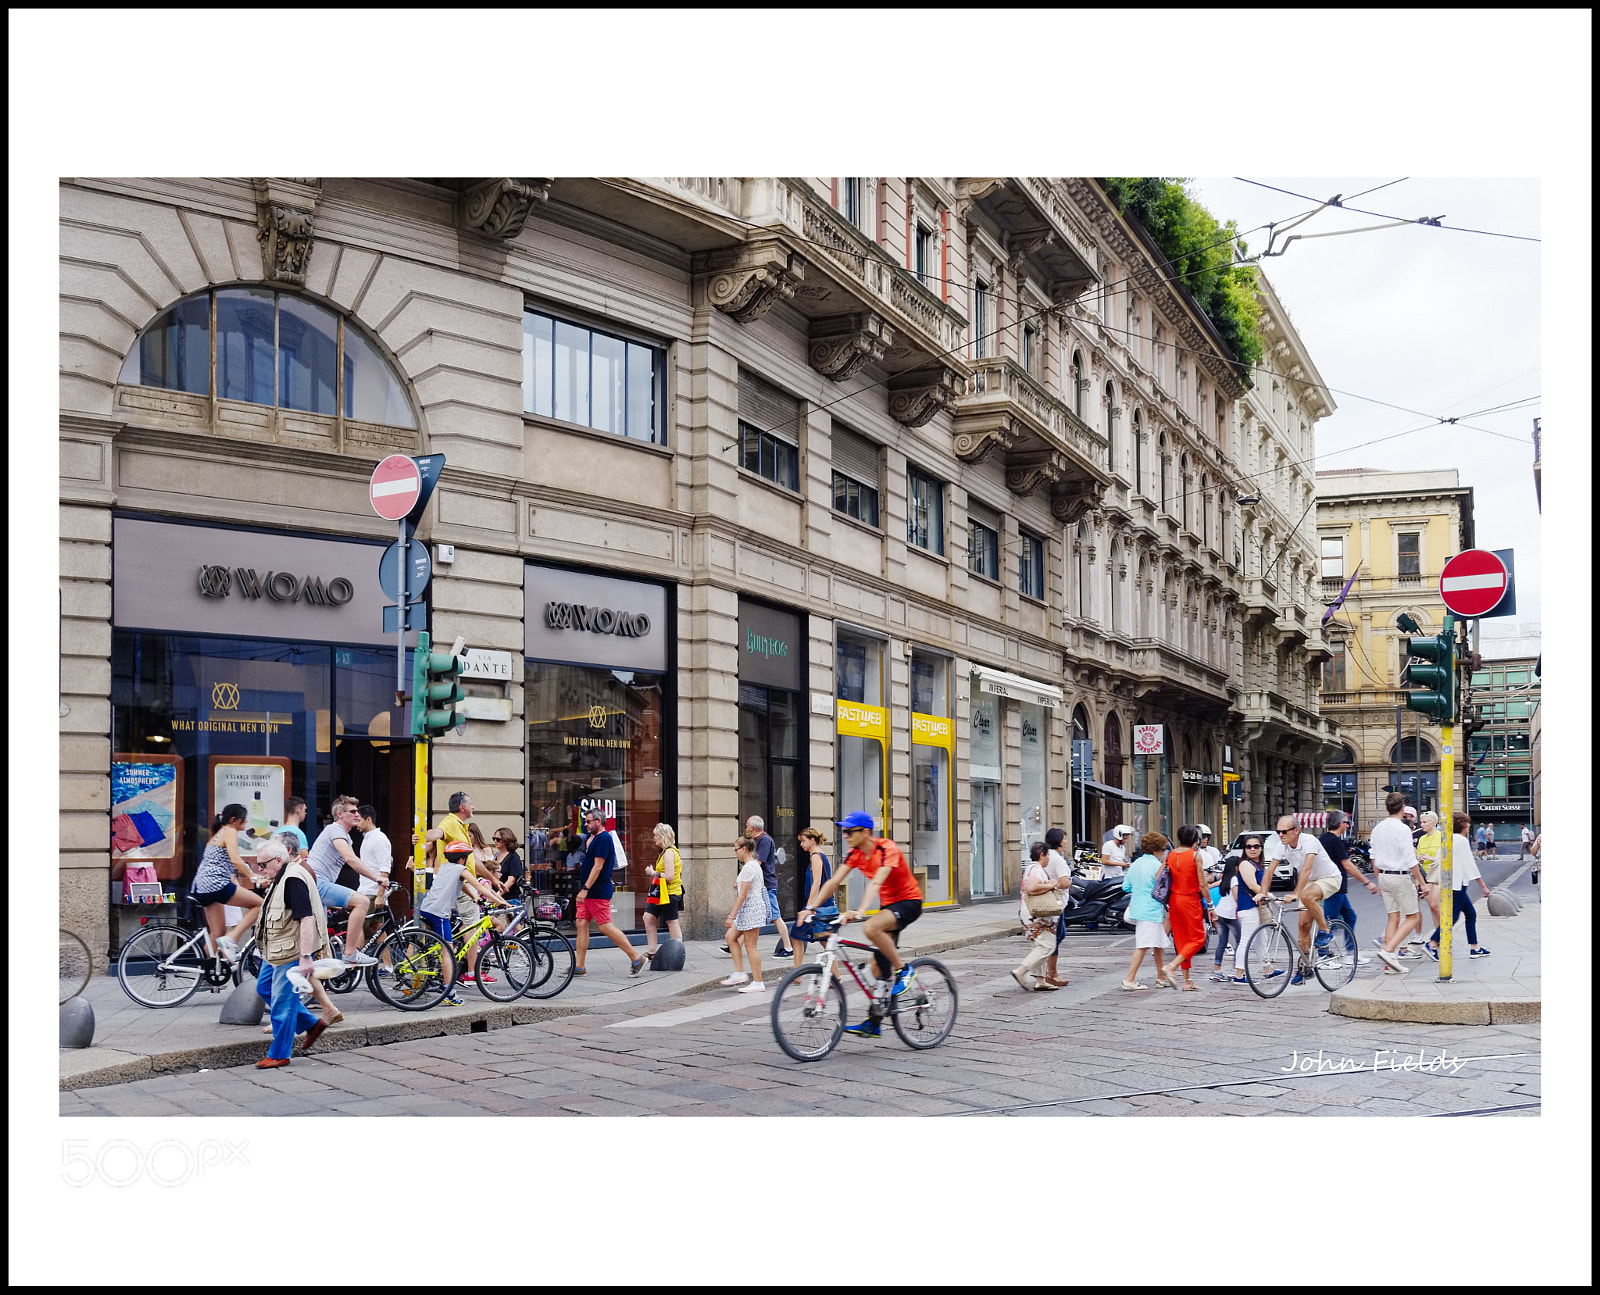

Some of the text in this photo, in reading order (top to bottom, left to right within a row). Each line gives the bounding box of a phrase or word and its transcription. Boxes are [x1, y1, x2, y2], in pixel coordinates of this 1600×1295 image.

[235, 567, 354, 606] WOMO
[571, 604, 651, 638] WOMO
[463, 661, 508, 675] DANTE
[837, 706, 882, 726] FASTWEB
[171, 720, 279, 734] WHAT ORIGINAL MEN OWN
[912, 718, 949, 736] FASTWEB
[563, 737, 631, 749] WHAT ORIGINAL MEN OWN
[126, 769, 150, 777] SUMMER
